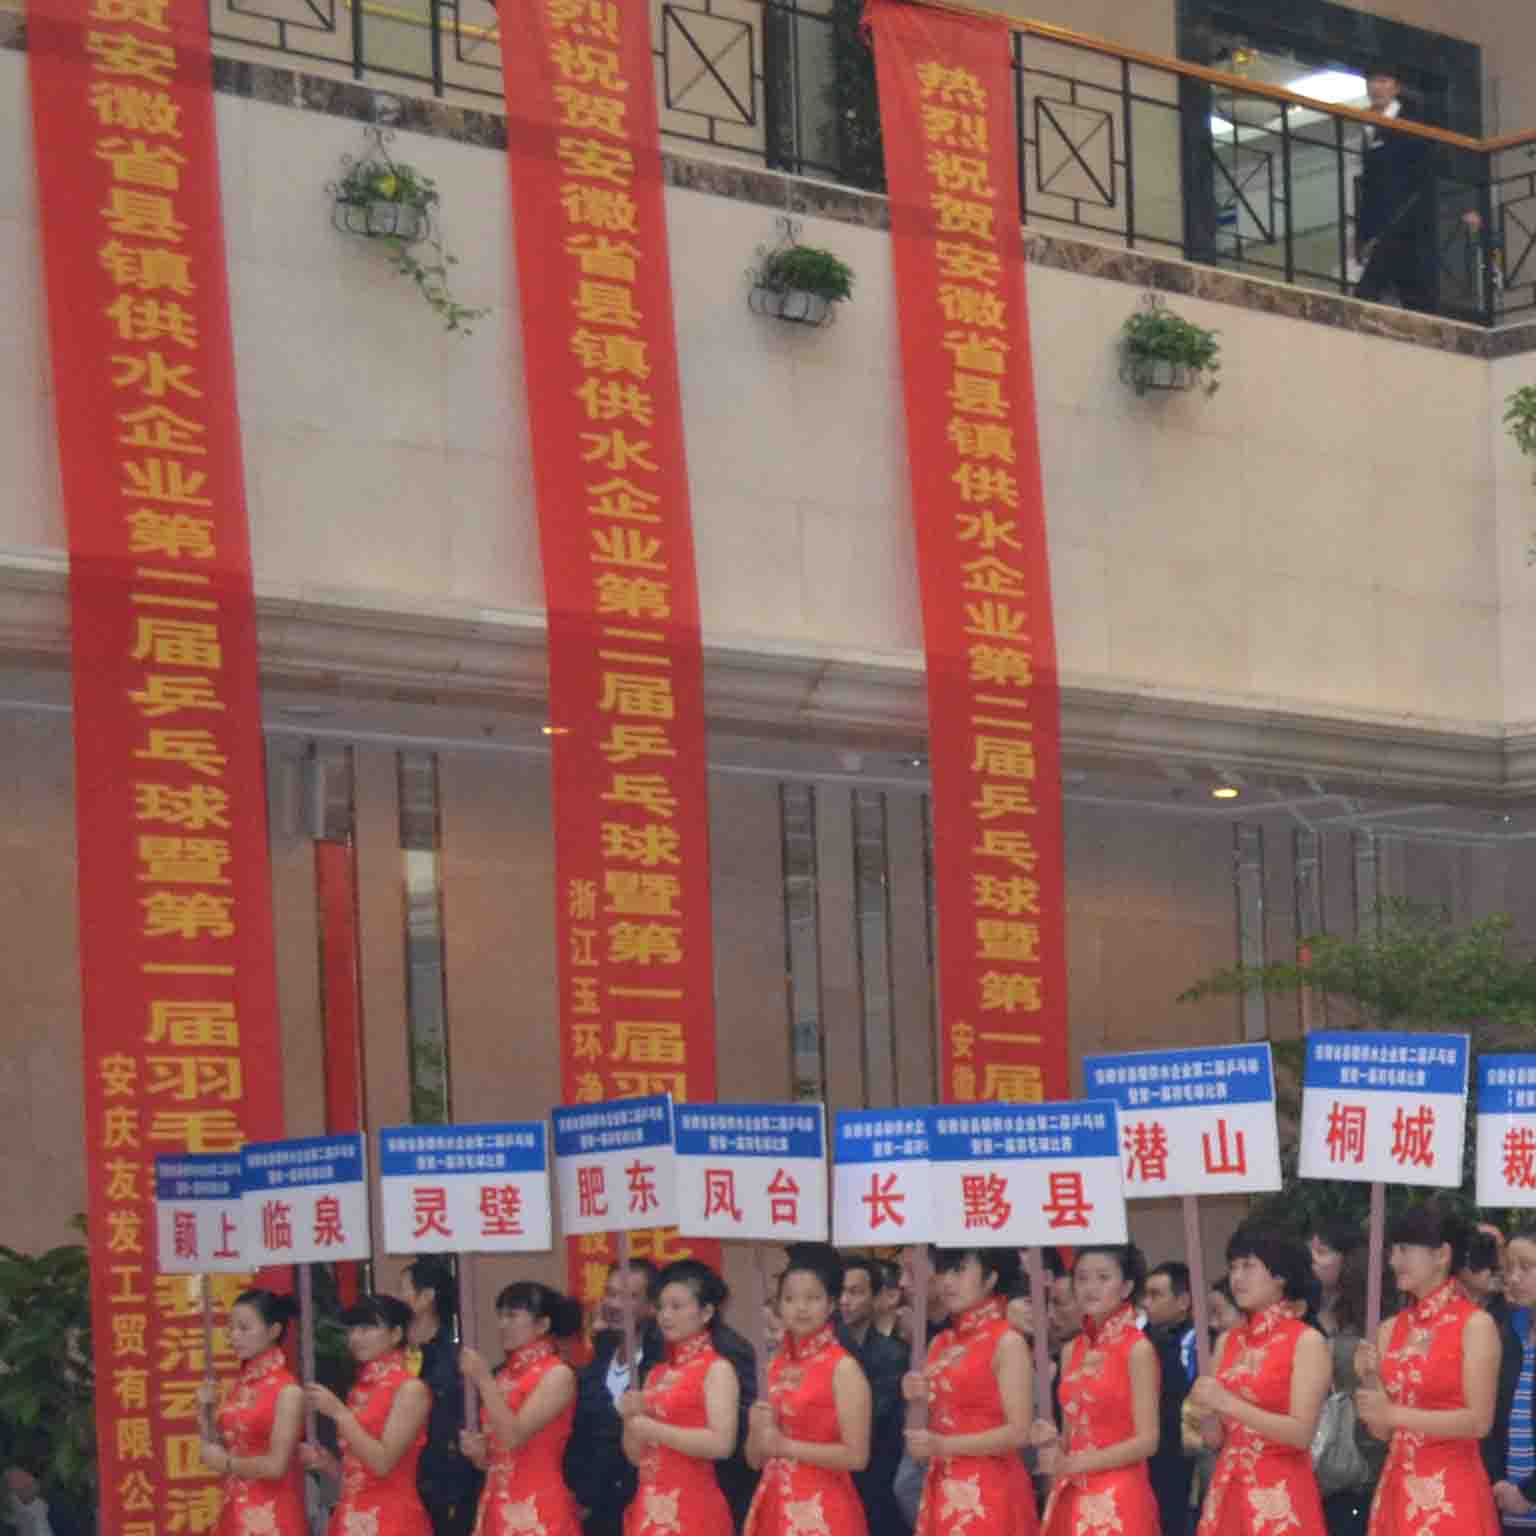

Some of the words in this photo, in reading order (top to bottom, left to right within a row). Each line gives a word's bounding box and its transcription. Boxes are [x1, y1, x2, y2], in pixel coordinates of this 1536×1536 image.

[1122, 1117, 1249, 1184] 潜山
[1324, 1100, 1436, 1169] 桐城
[576, 1159, 660, 1218] 肥东
[703, 1167, 801, 1226] 凤台
[861, 1171, 906, 1231] 长
[960, 1171, 1095, 1231] 黟县
[261, 1194, 347, 1251] 临泉
